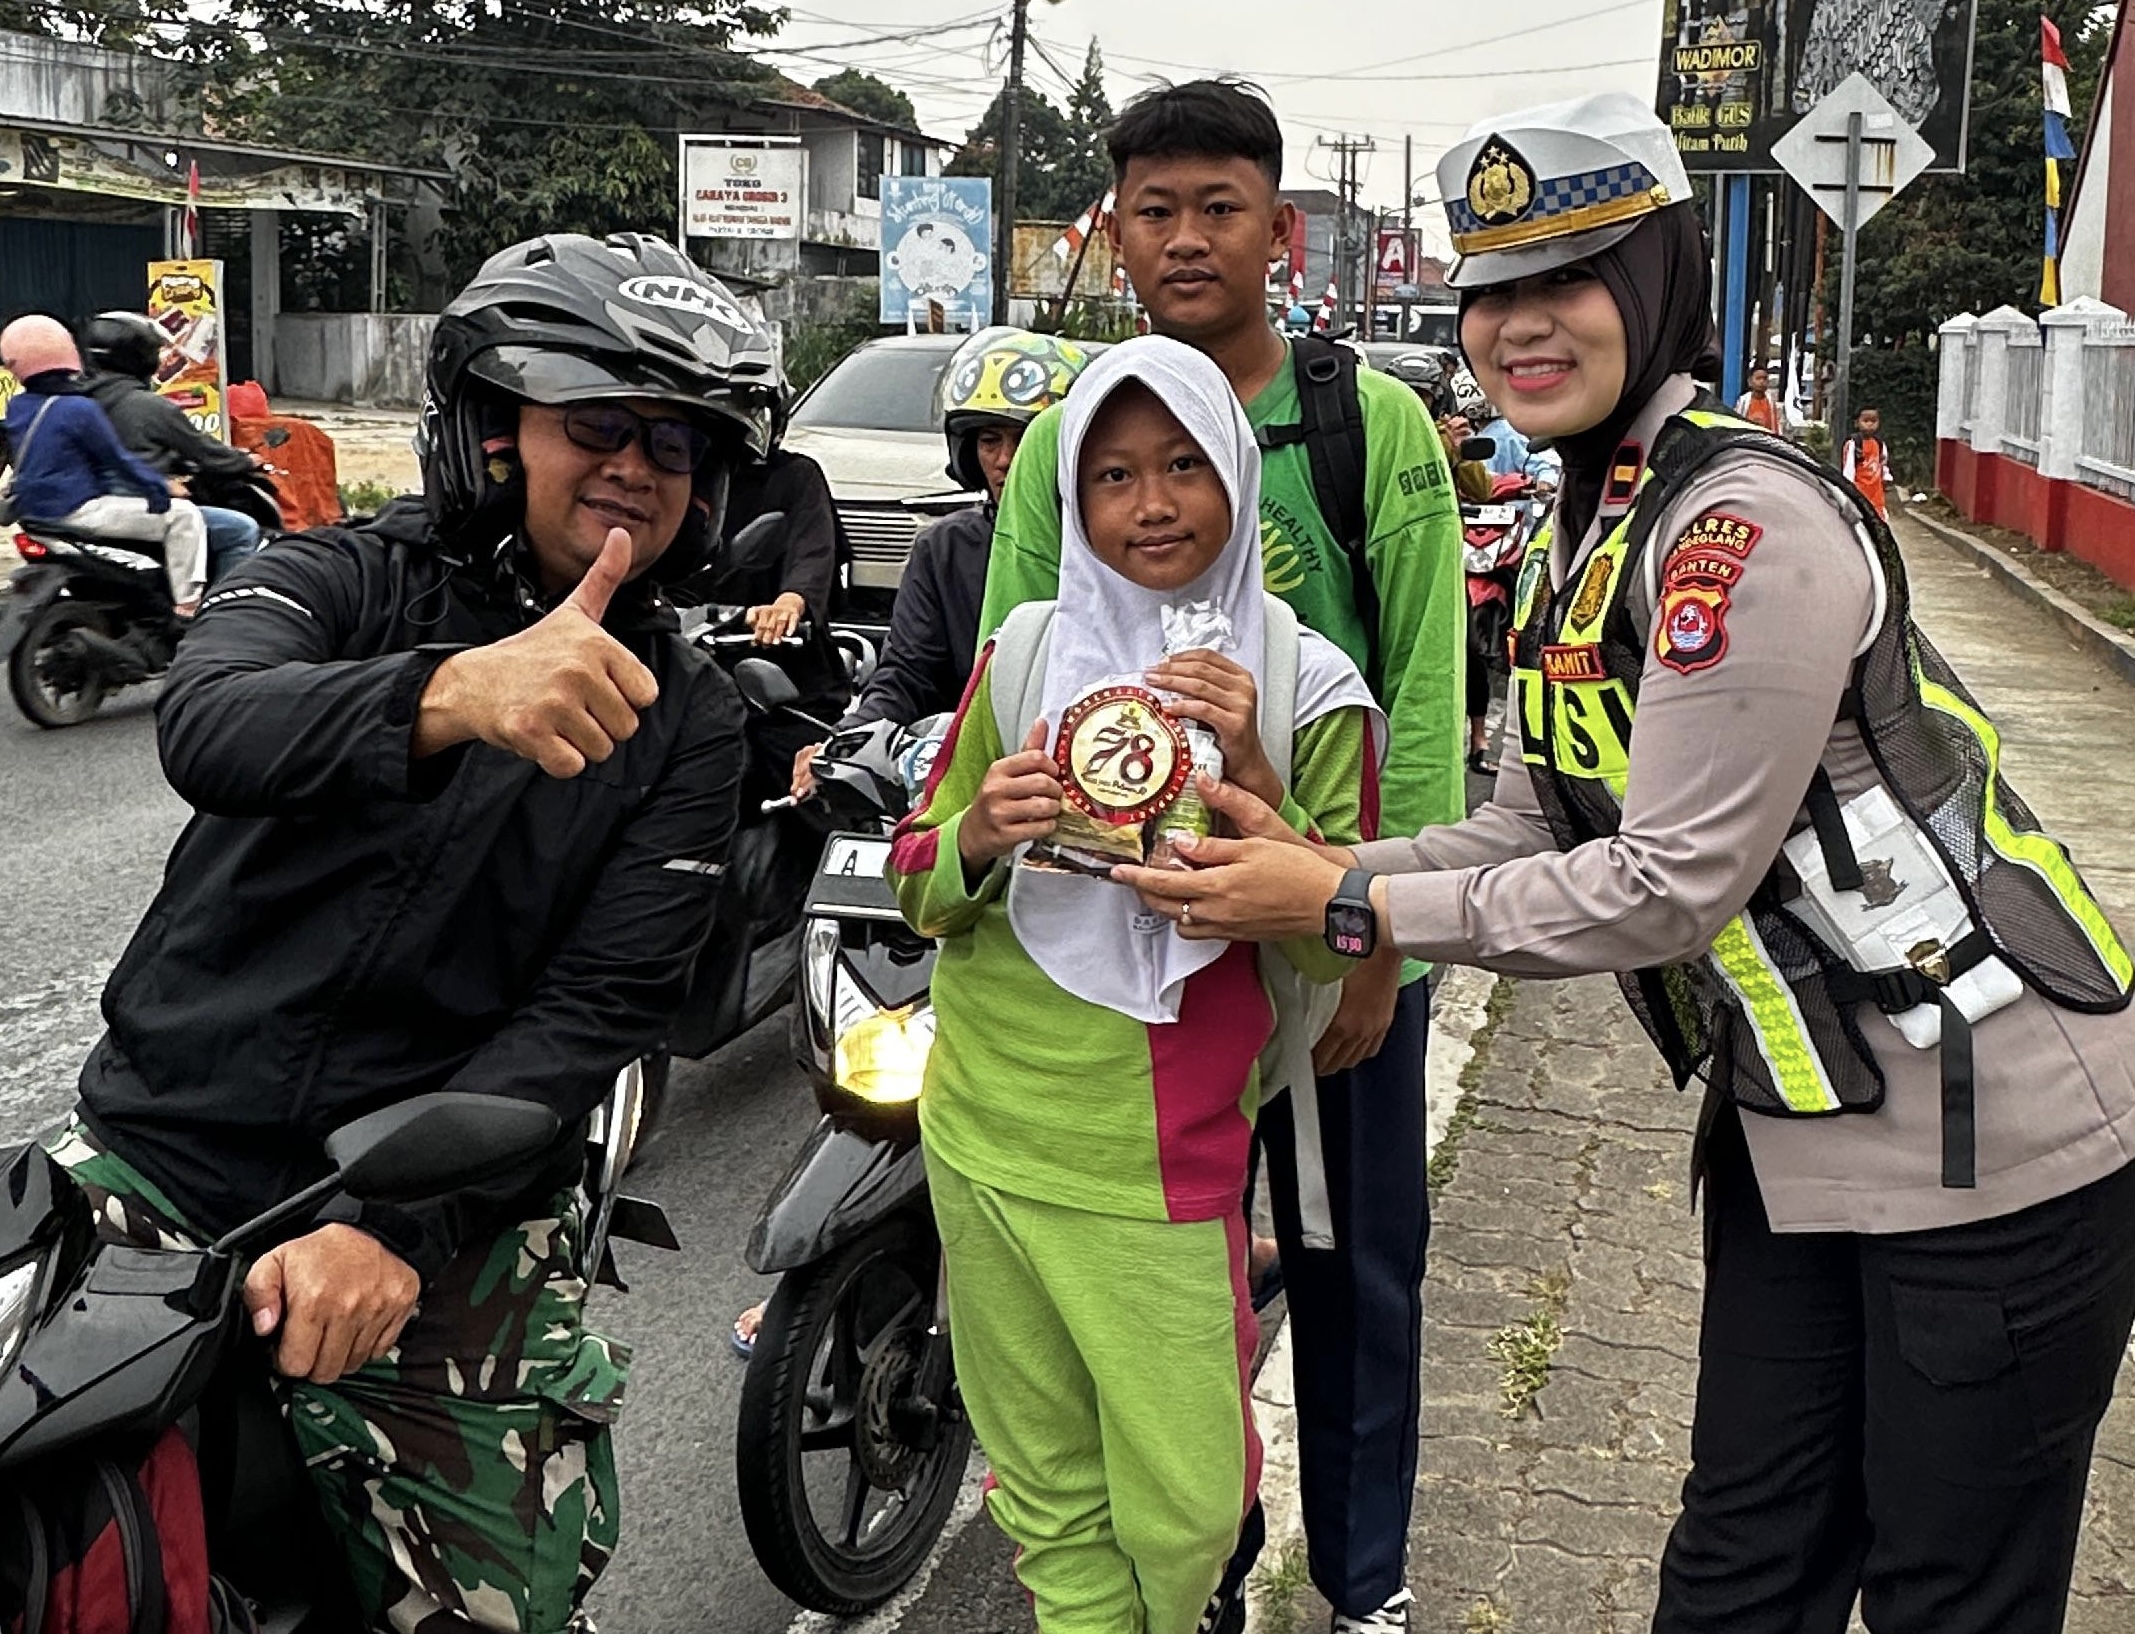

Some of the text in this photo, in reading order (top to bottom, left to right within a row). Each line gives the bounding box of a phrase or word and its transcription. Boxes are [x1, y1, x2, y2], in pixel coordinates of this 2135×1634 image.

[1676, 45, 1757, 71] WADIMOR
[1260, 496, 1323, 572] HEALTHY
[841, 850, 858, 875] A
